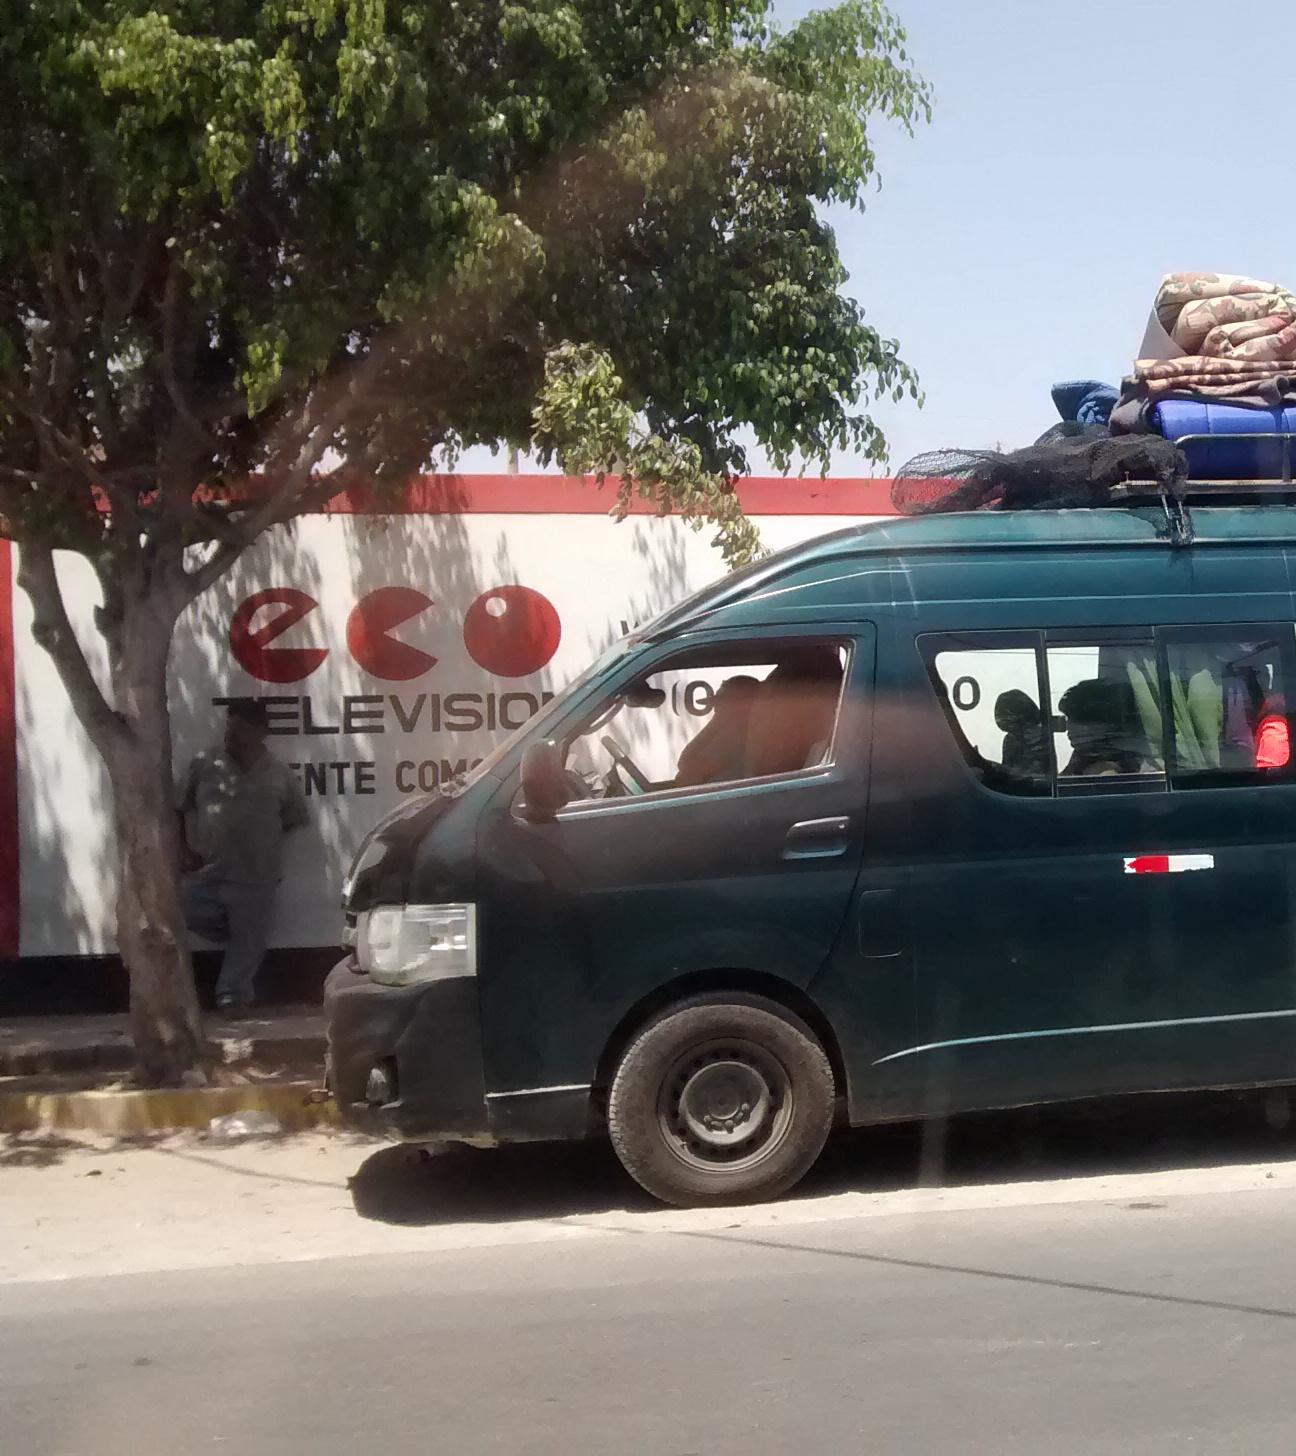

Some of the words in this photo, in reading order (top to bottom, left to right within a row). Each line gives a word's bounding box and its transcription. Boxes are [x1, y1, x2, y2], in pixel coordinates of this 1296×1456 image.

[211, 691, 556, 735] TELEVISIO
[288, 760, 376, 796] NTE
[395, 758, 484, 794] COM
